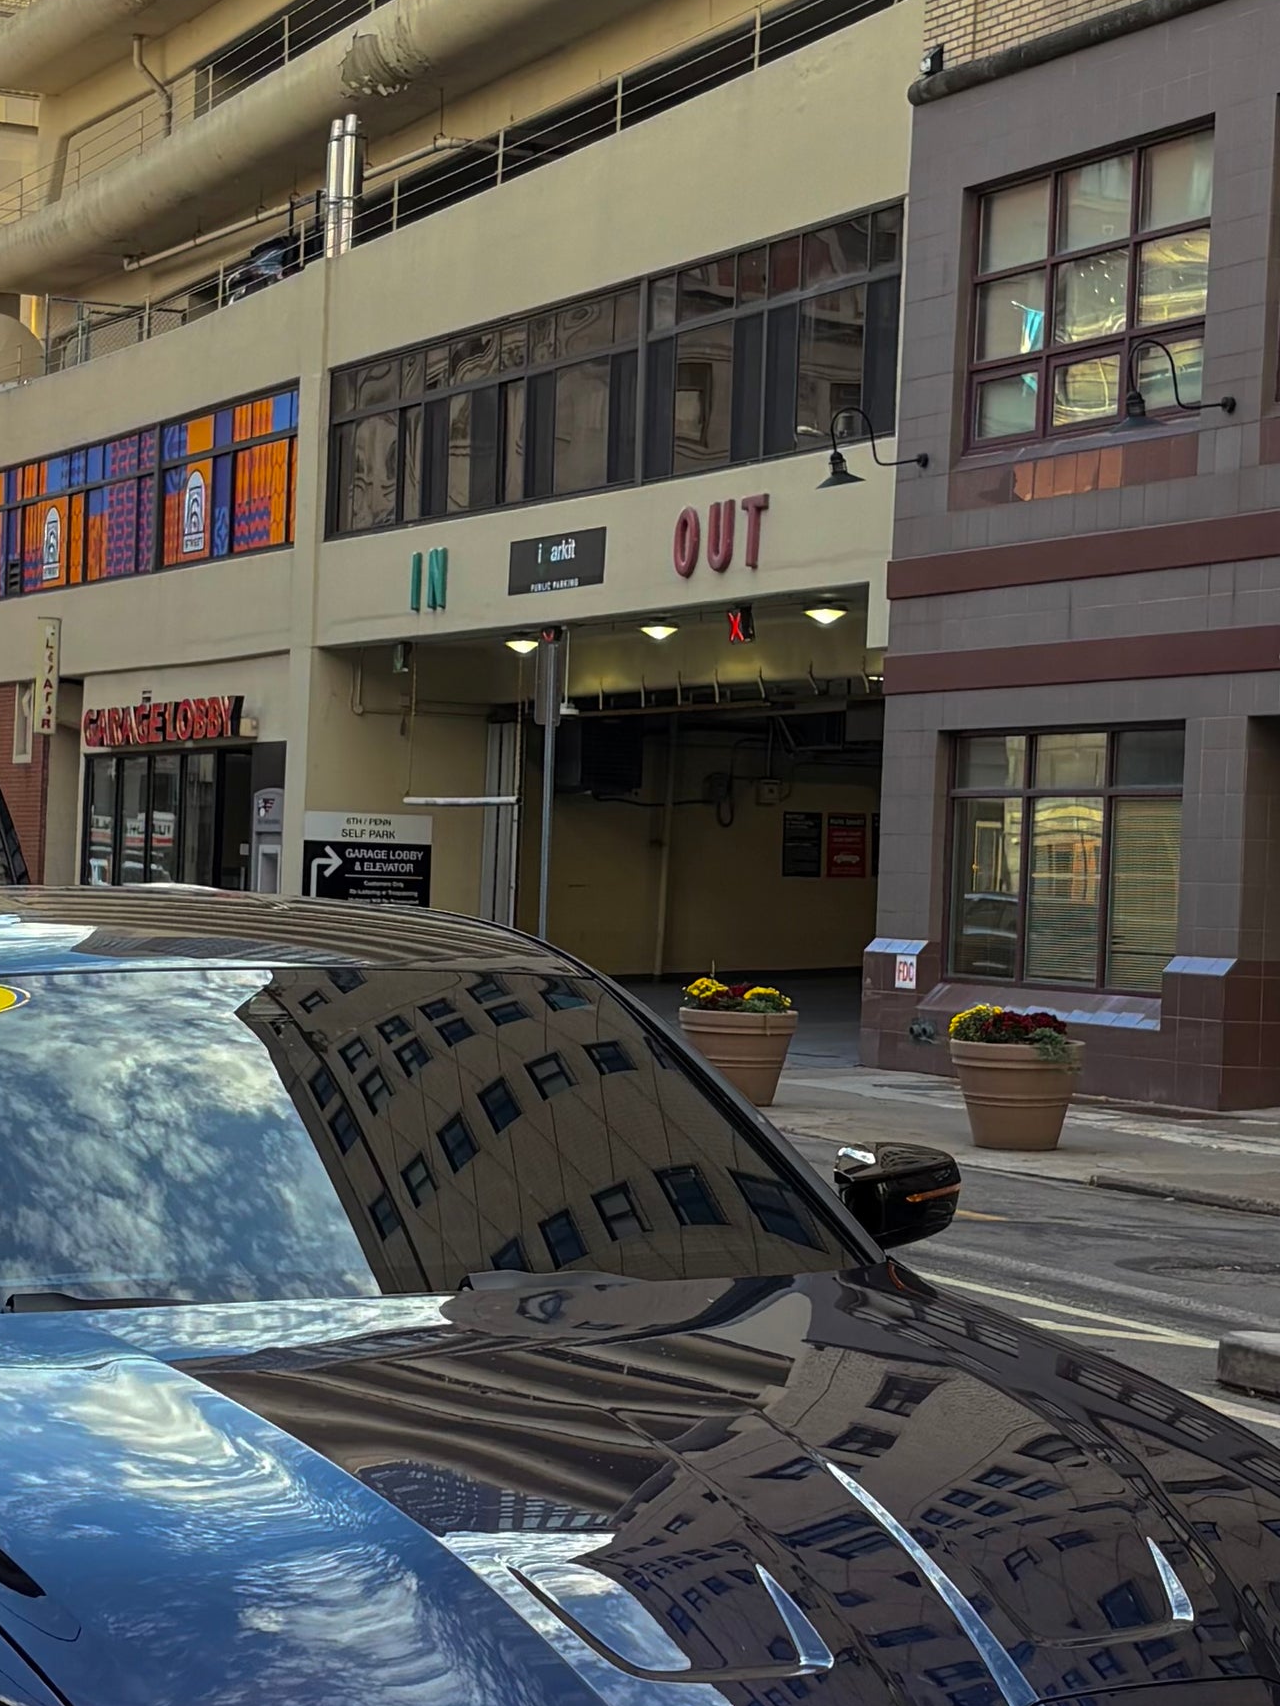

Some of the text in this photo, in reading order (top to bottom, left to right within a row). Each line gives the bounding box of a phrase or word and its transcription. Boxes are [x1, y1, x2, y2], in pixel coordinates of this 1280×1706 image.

[673, 493, 770, 579] OUT
[538, 538, 576, 564] iarkit
[410, 546, 448, 612] IN
[83, 696, 235, 747] GARAGE LOBBY
[341, 828, 396, 839] SELF PARK
[345, 848, 424, 861] GARAGE LOBBY
[364, 862, 414, 873] ELEVATOR
